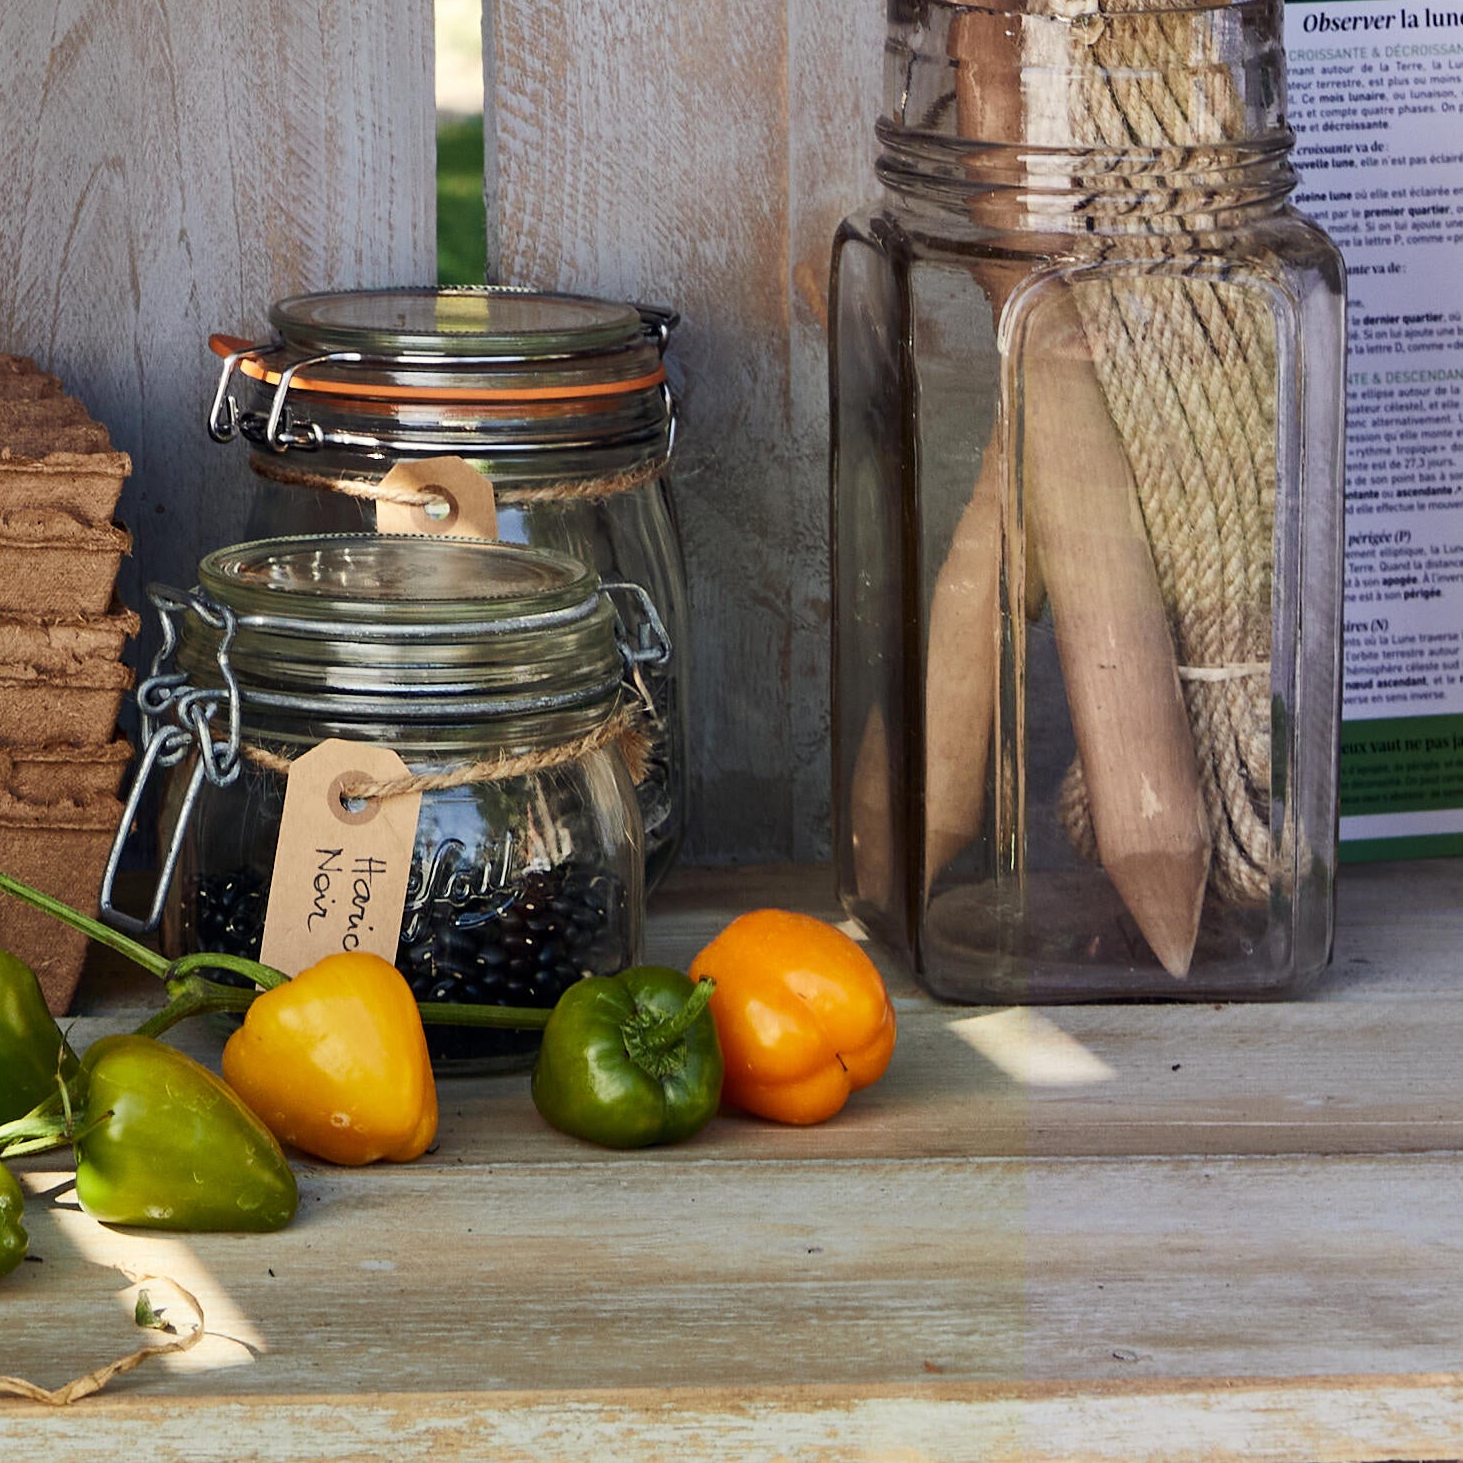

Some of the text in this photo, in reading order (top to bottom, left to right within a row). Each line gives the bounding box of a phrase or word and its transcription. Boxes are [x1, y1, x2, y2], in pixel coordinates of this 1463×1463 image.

[1303, 8, 1463, 33] Observer la lun
[1289, 47, 1368, 62] CROISSANTE
[1361, 64, 1373, 73] de
[1319, 94, 1345, 103] mois
[1295, 192, 1326, 204] pleine
[1329, 190, 1352, 201] lune
[343, 855, 387, 952] Haric
